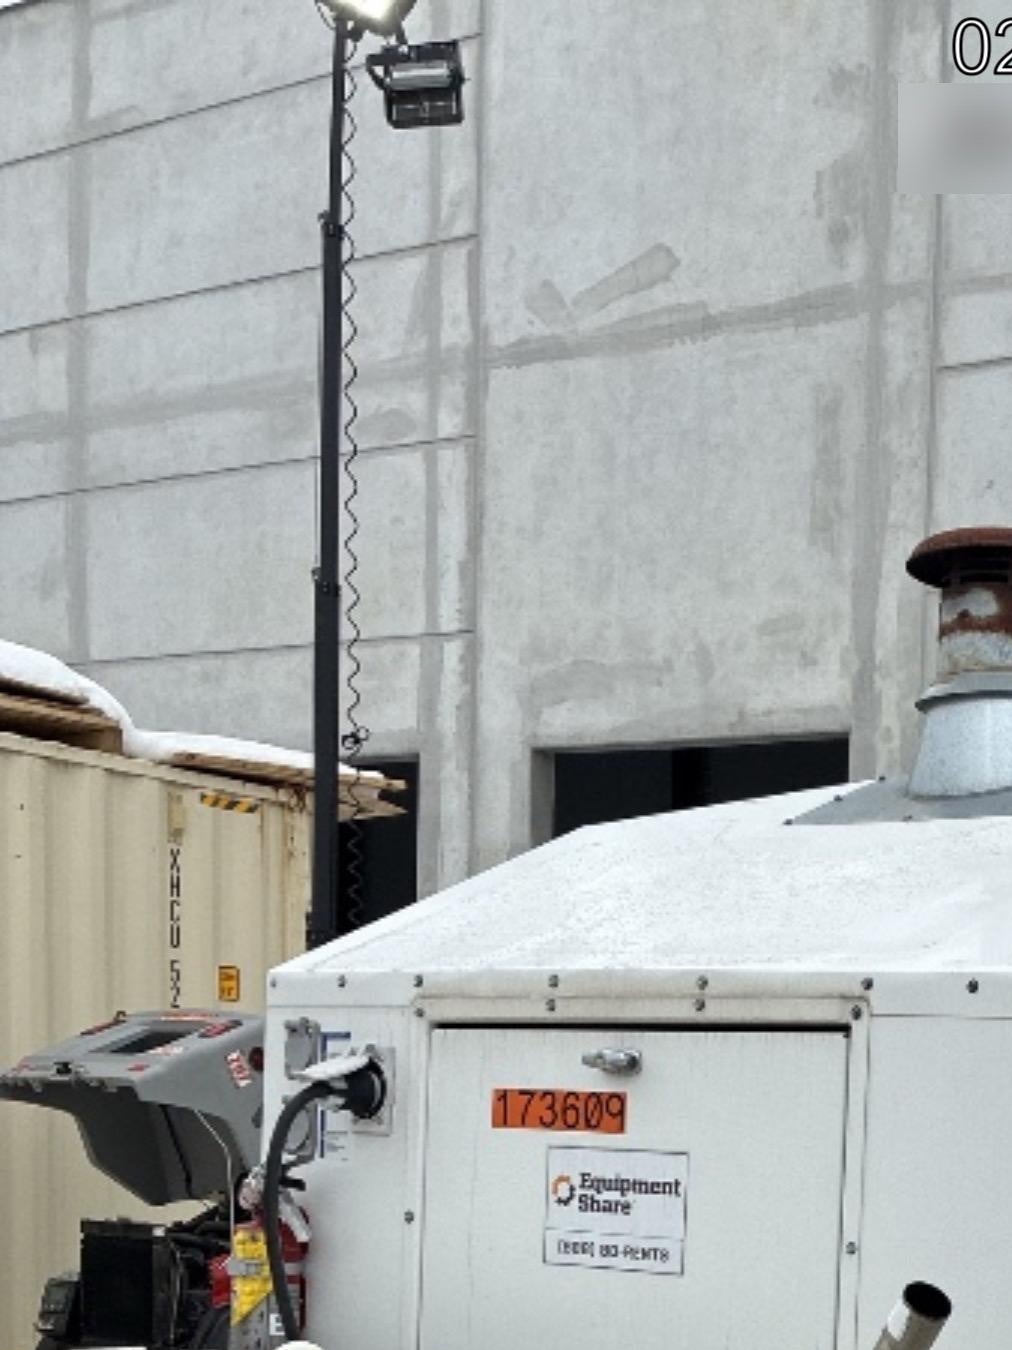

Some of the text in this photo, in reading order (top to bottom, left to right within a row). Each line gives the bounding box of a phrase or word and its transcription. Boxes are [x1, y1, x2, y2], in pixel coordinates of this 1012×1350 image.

[170, 848, 181, 948] XHCU
[496, 1089, 626, 1132] 173609
[579, 1172, 681, 1198] Equipment
[578, 1194, 633, 1215] Share
